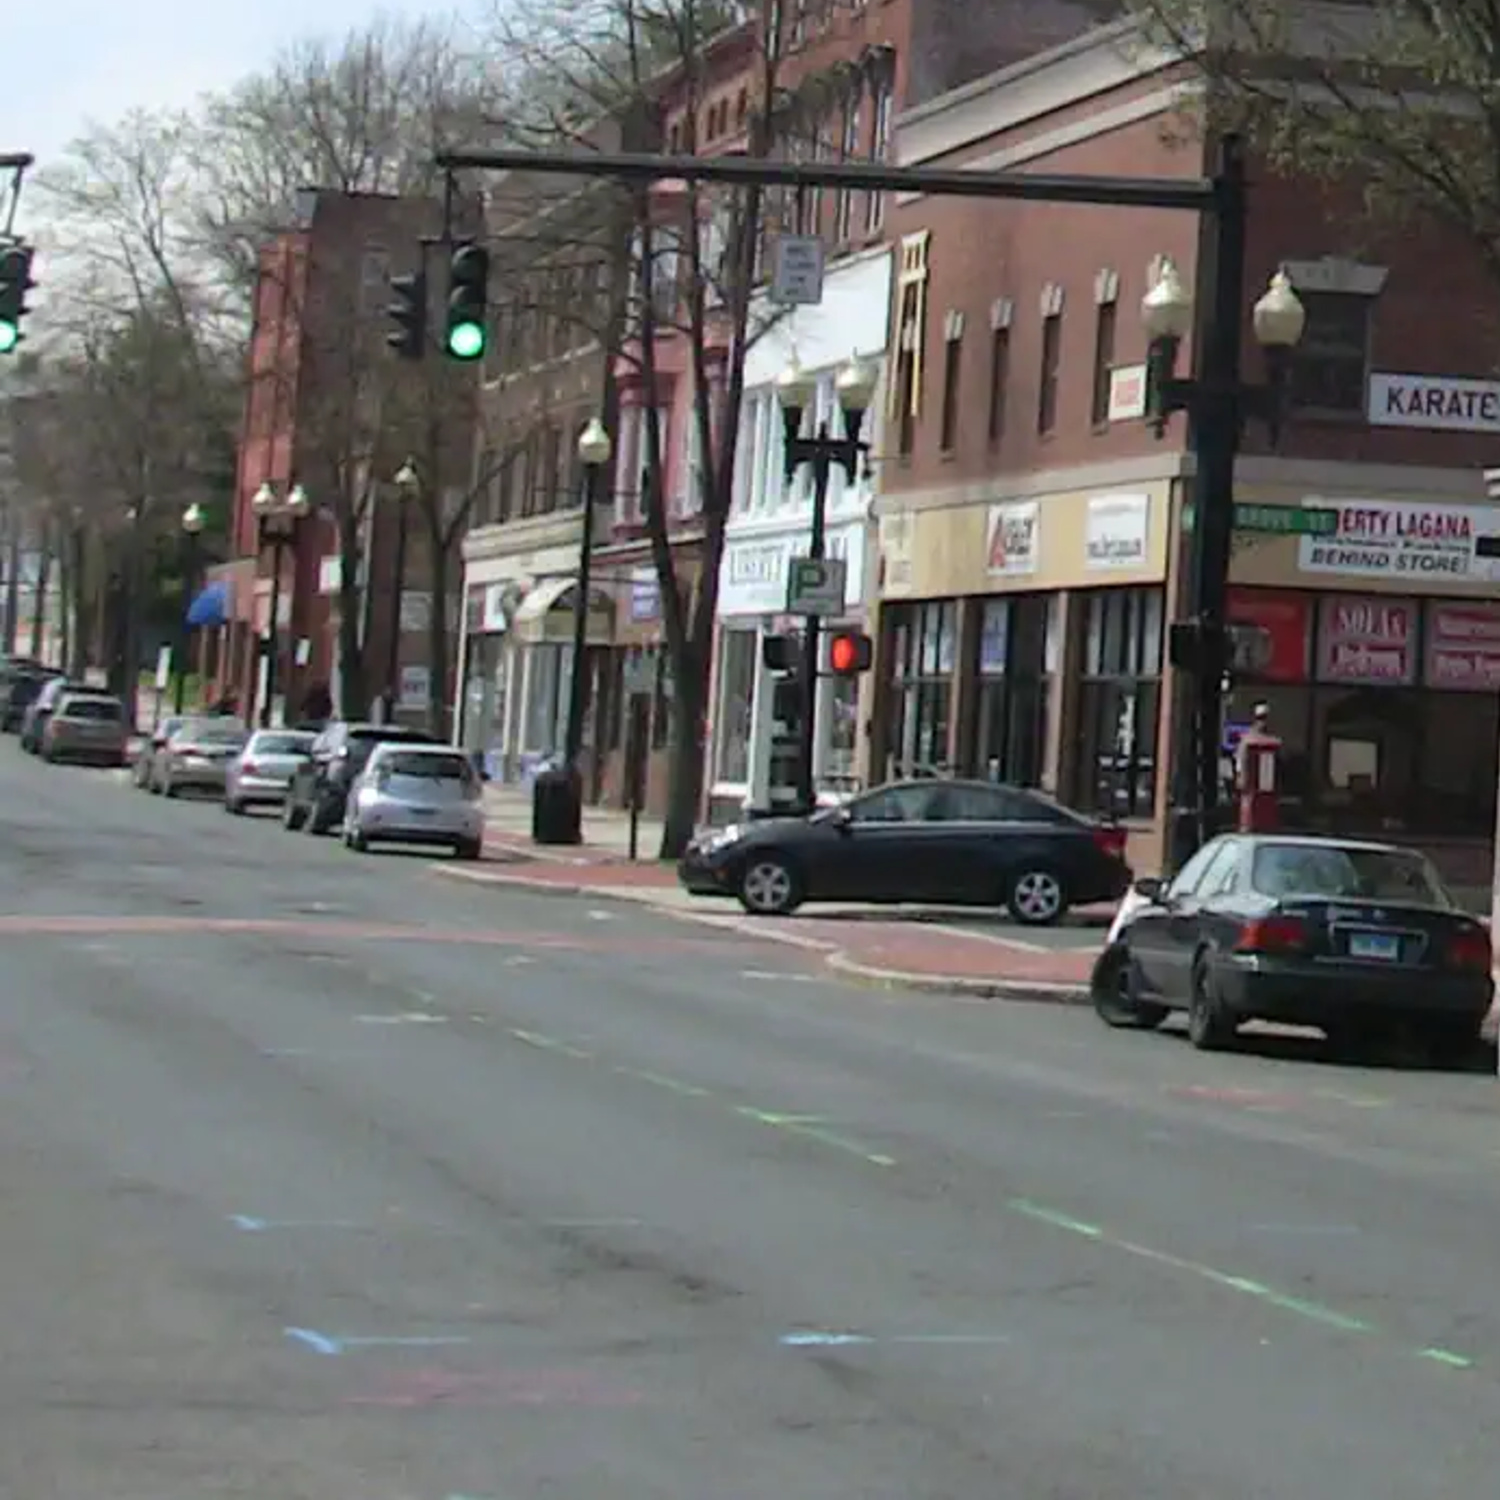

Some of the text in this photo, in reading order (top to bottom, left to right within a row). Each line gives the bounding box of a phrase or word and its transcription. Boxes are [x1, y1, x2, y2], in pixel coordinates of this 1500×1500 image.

[1387, 385, 1498, 420] KARATE
[1397, 510, 1470, 539] LAGANA
[1310, 548, 1390, 569] BEHIND
